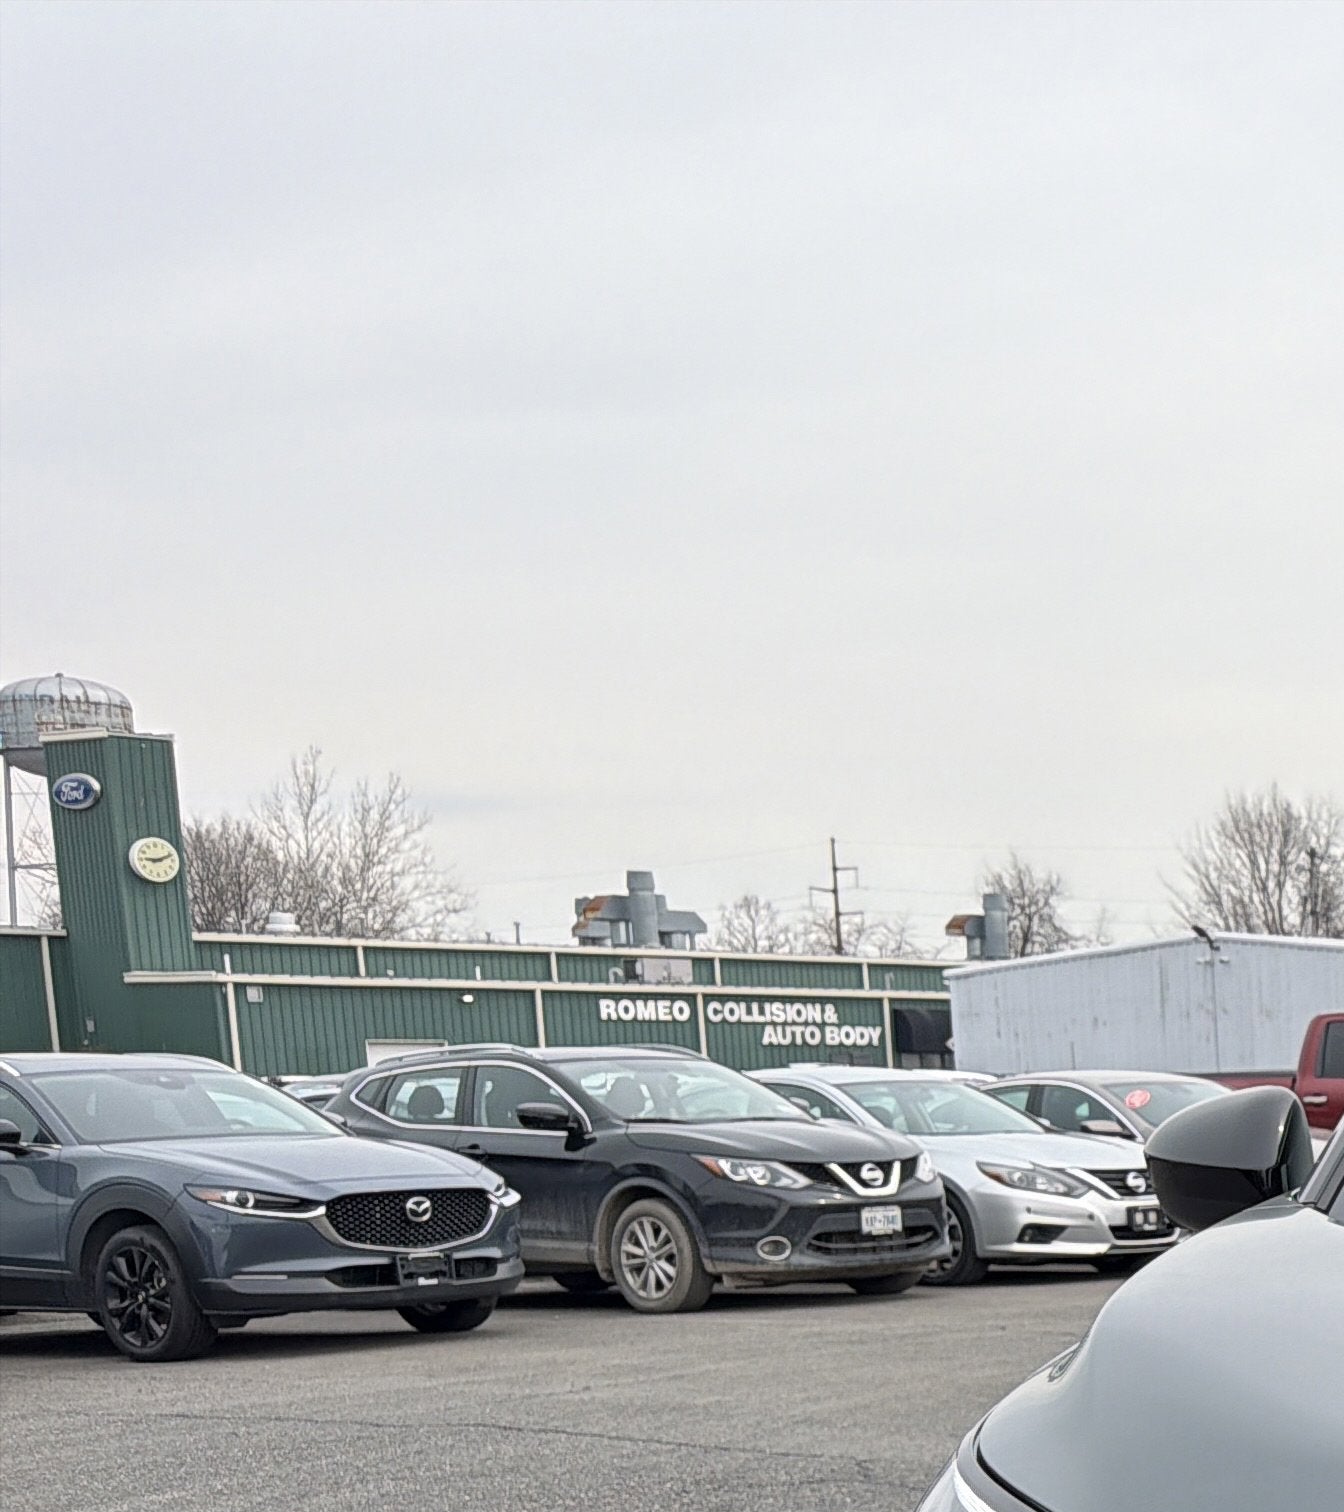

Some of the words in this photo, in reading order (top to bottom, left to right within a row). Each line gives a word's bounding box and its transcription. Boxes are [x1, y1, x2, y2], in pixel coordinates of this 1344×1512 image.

[60, 782, 85, 801] Ford
[600, 999, 691, 1022] ROMEO
[706, 1001, 822, 1023] COLLISION
[823, 1004, 838, 1024] &
[762, 1025, 822, 1046] AUTO
[825, 1025, 882, 1046] BODY
